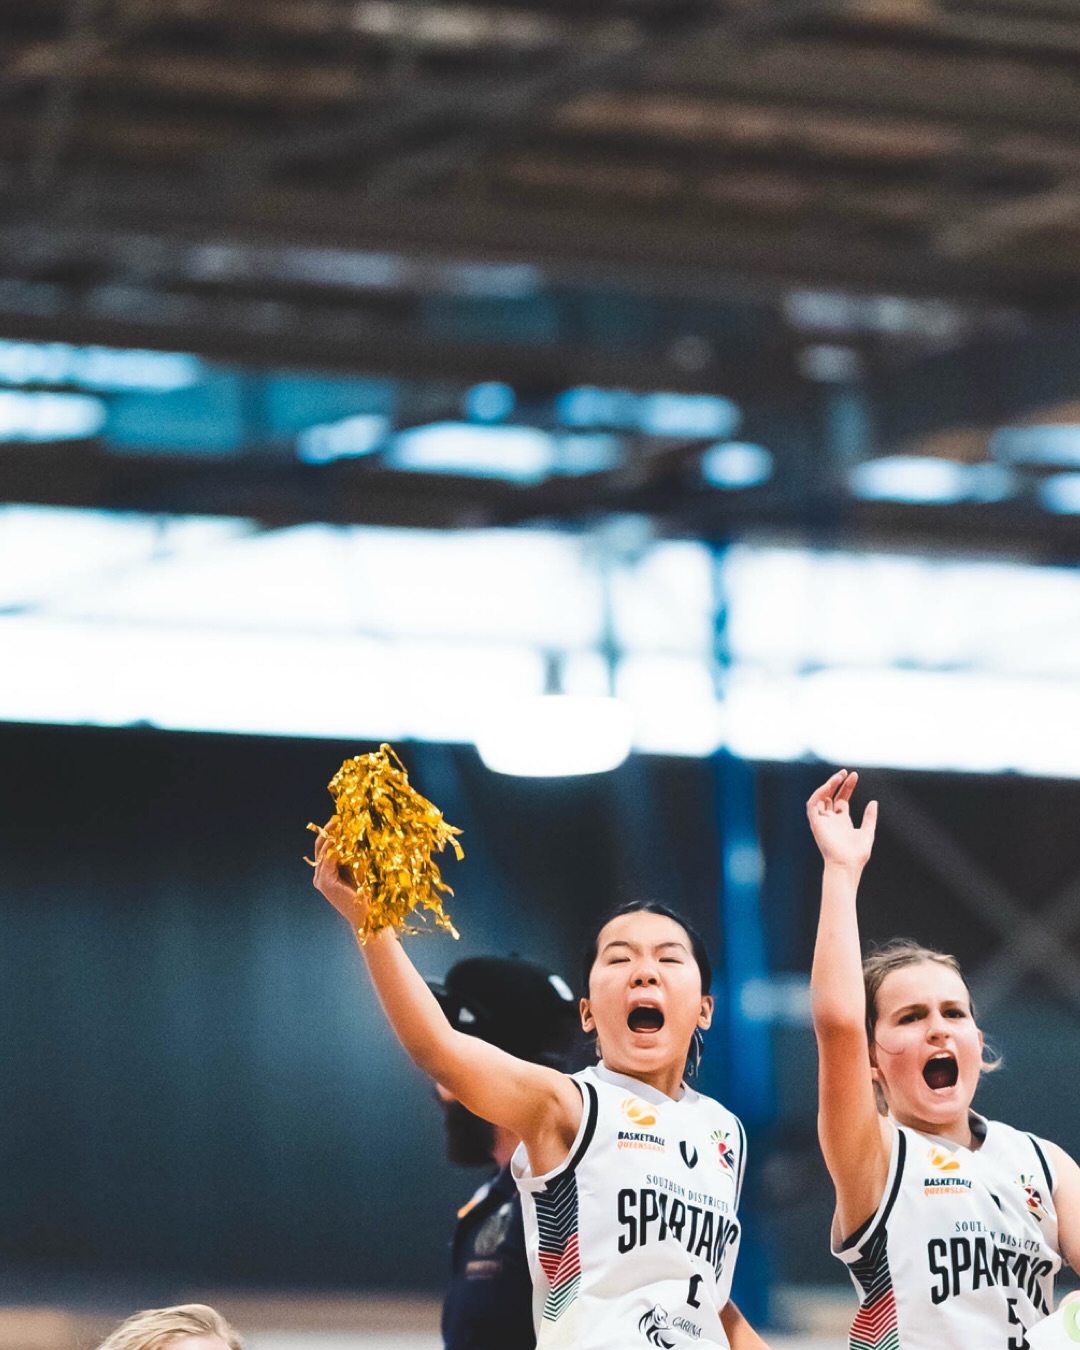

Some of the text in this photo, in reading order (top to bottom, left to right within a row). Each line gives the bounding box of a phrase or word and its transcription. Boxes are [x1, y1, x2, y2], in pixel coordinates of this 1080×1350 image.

[617, 1131, 665, 1146] BASKETBALL
[924, 1177, 972, 1189] BASKETBALL
[688, 1189, 729, 1214] DISTRICTS
